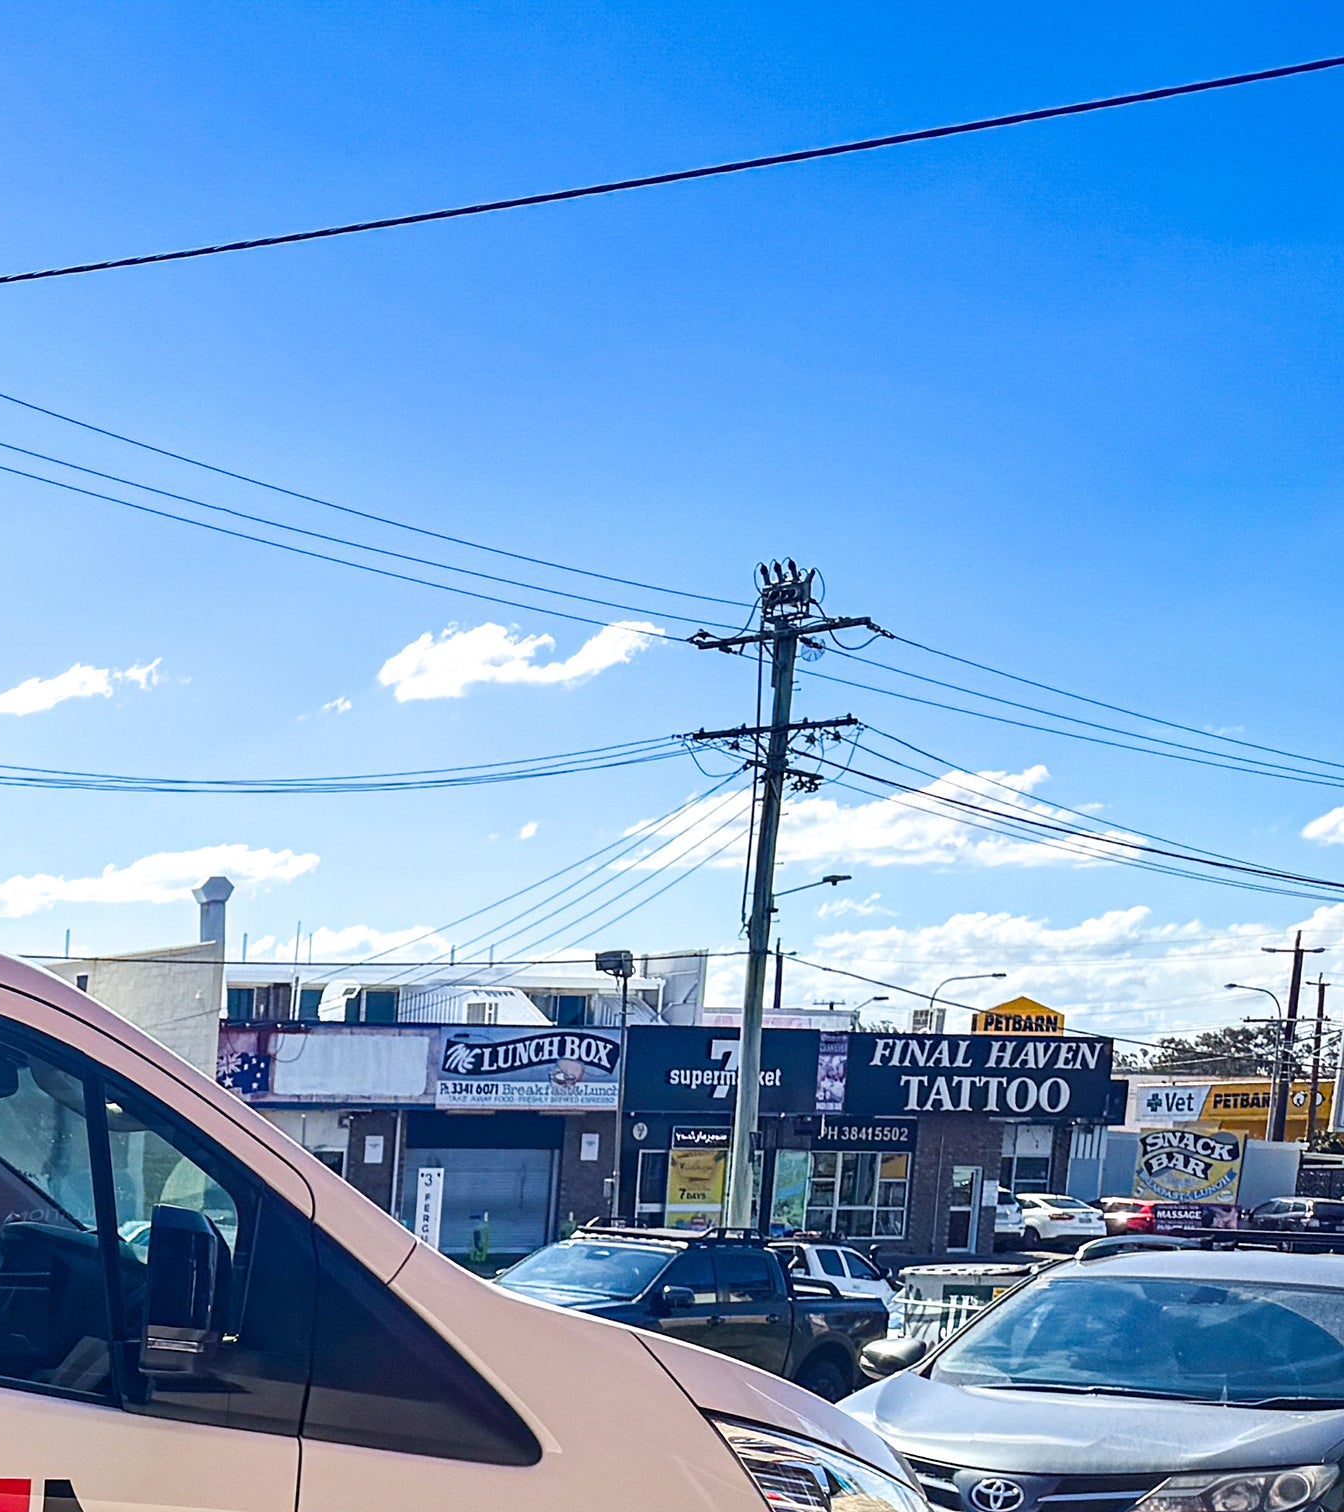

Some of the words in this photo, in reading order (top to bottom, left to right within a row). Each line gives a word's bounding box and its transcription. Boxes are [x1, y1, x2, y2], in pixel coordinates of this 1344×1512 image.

[983, 1014, 1058, 1032] PETBARN
[480, 1036, 561, 1071] LUNCH
[565, 1036, 613, 1068] BOX
[869, 1039, 973, 1067] FINAL
[985, 1040, 1103, 1070] HAVEN
[669, 1068, 782, 1089] supermket
[710, 1039, 740, 1098] 7
[451, 1082, 473, 1095] 3341
[476, 1083, 499, 1095] 6071
[900, 1075, 1071, 1112] TATTOO
[1165, 1092, 1194, 1112] Vet
[1213, 1093, 1270, 1109] PETBAR
[841, 1127, 908, 1141] 38415502
[1145, 1131, 1233, 1161] SNACK
[1149, 1152, 1205, 1178] BAR
[424, 1173, 433, 1186] 3
[679, 1188, 686, 1199] 7
[1156, 1210, 1202, 1220] MASSAGE
